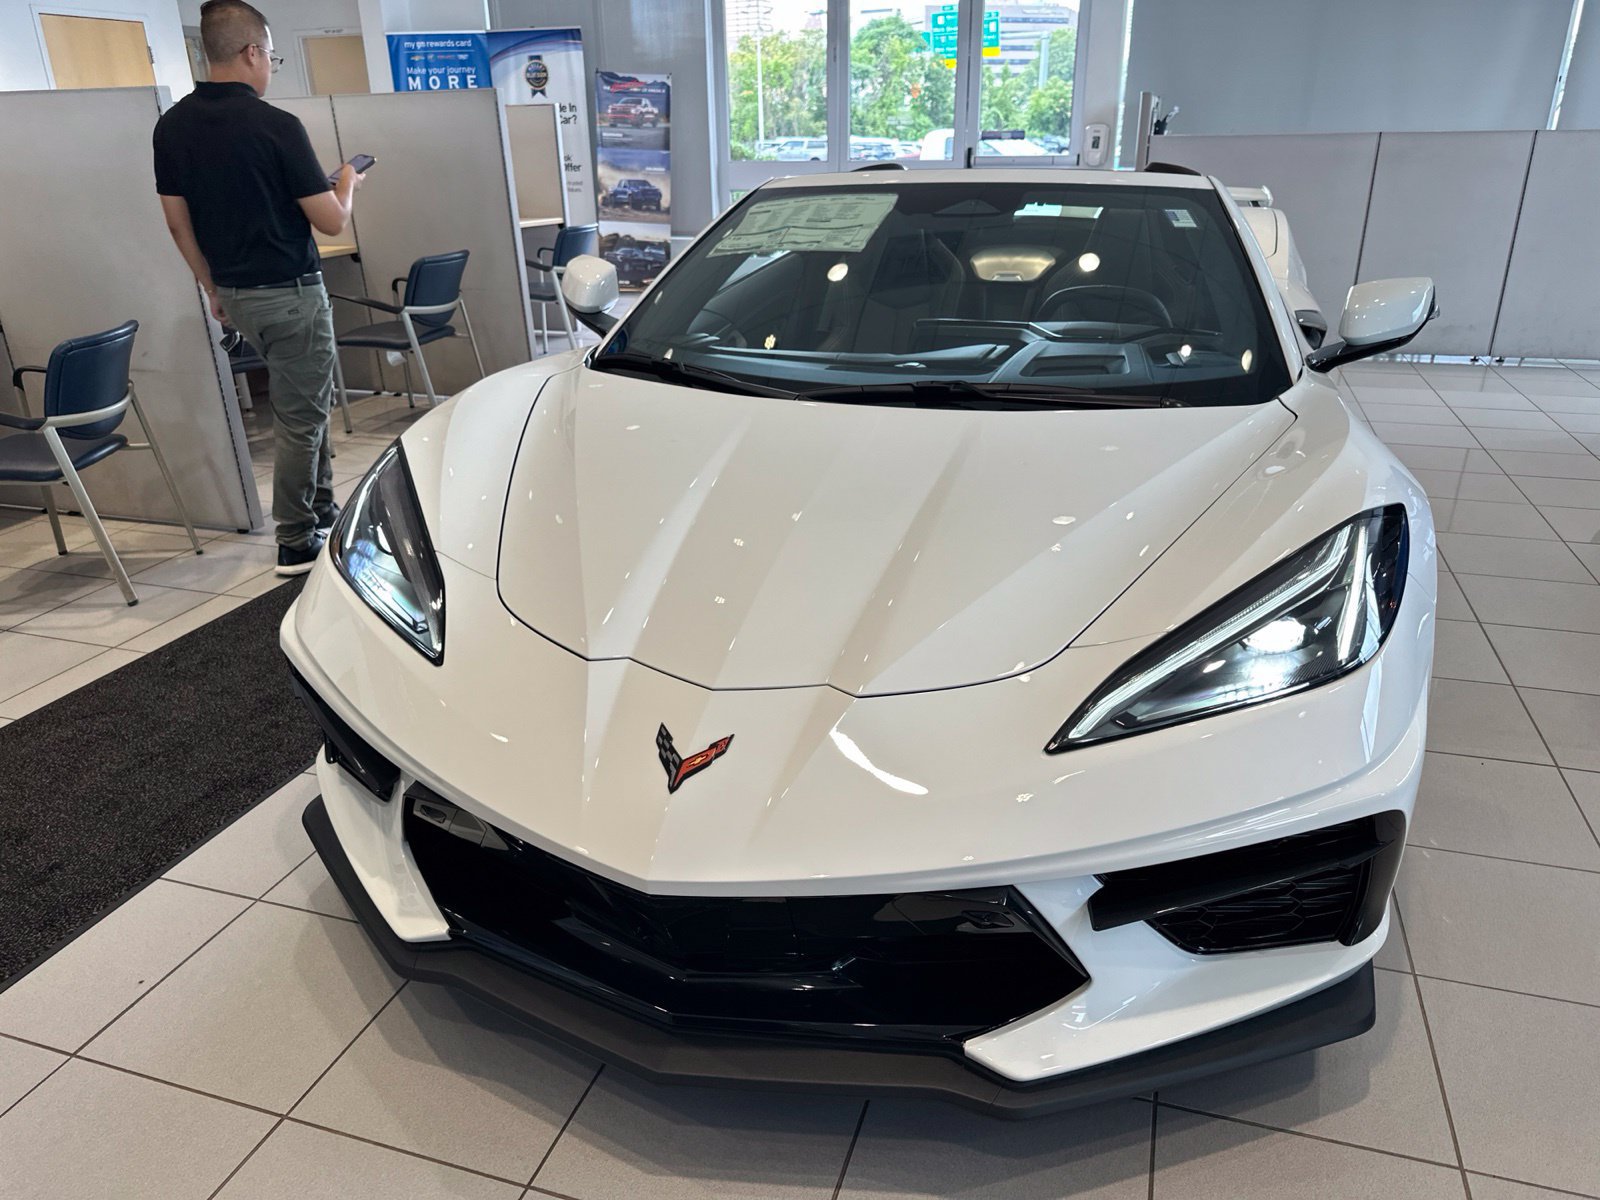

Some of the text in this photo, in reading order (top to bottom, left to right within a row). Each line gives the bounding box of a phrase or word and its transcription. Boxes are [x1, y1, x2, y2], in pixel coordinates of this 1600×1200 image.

[404, 41, 415, 49] my
[426, 40, 455, 48] rewards
[406, 66, 476, 75] Make your journey
[408, 75, 478, 90] MORE
[569, 103, 577, 113] In
